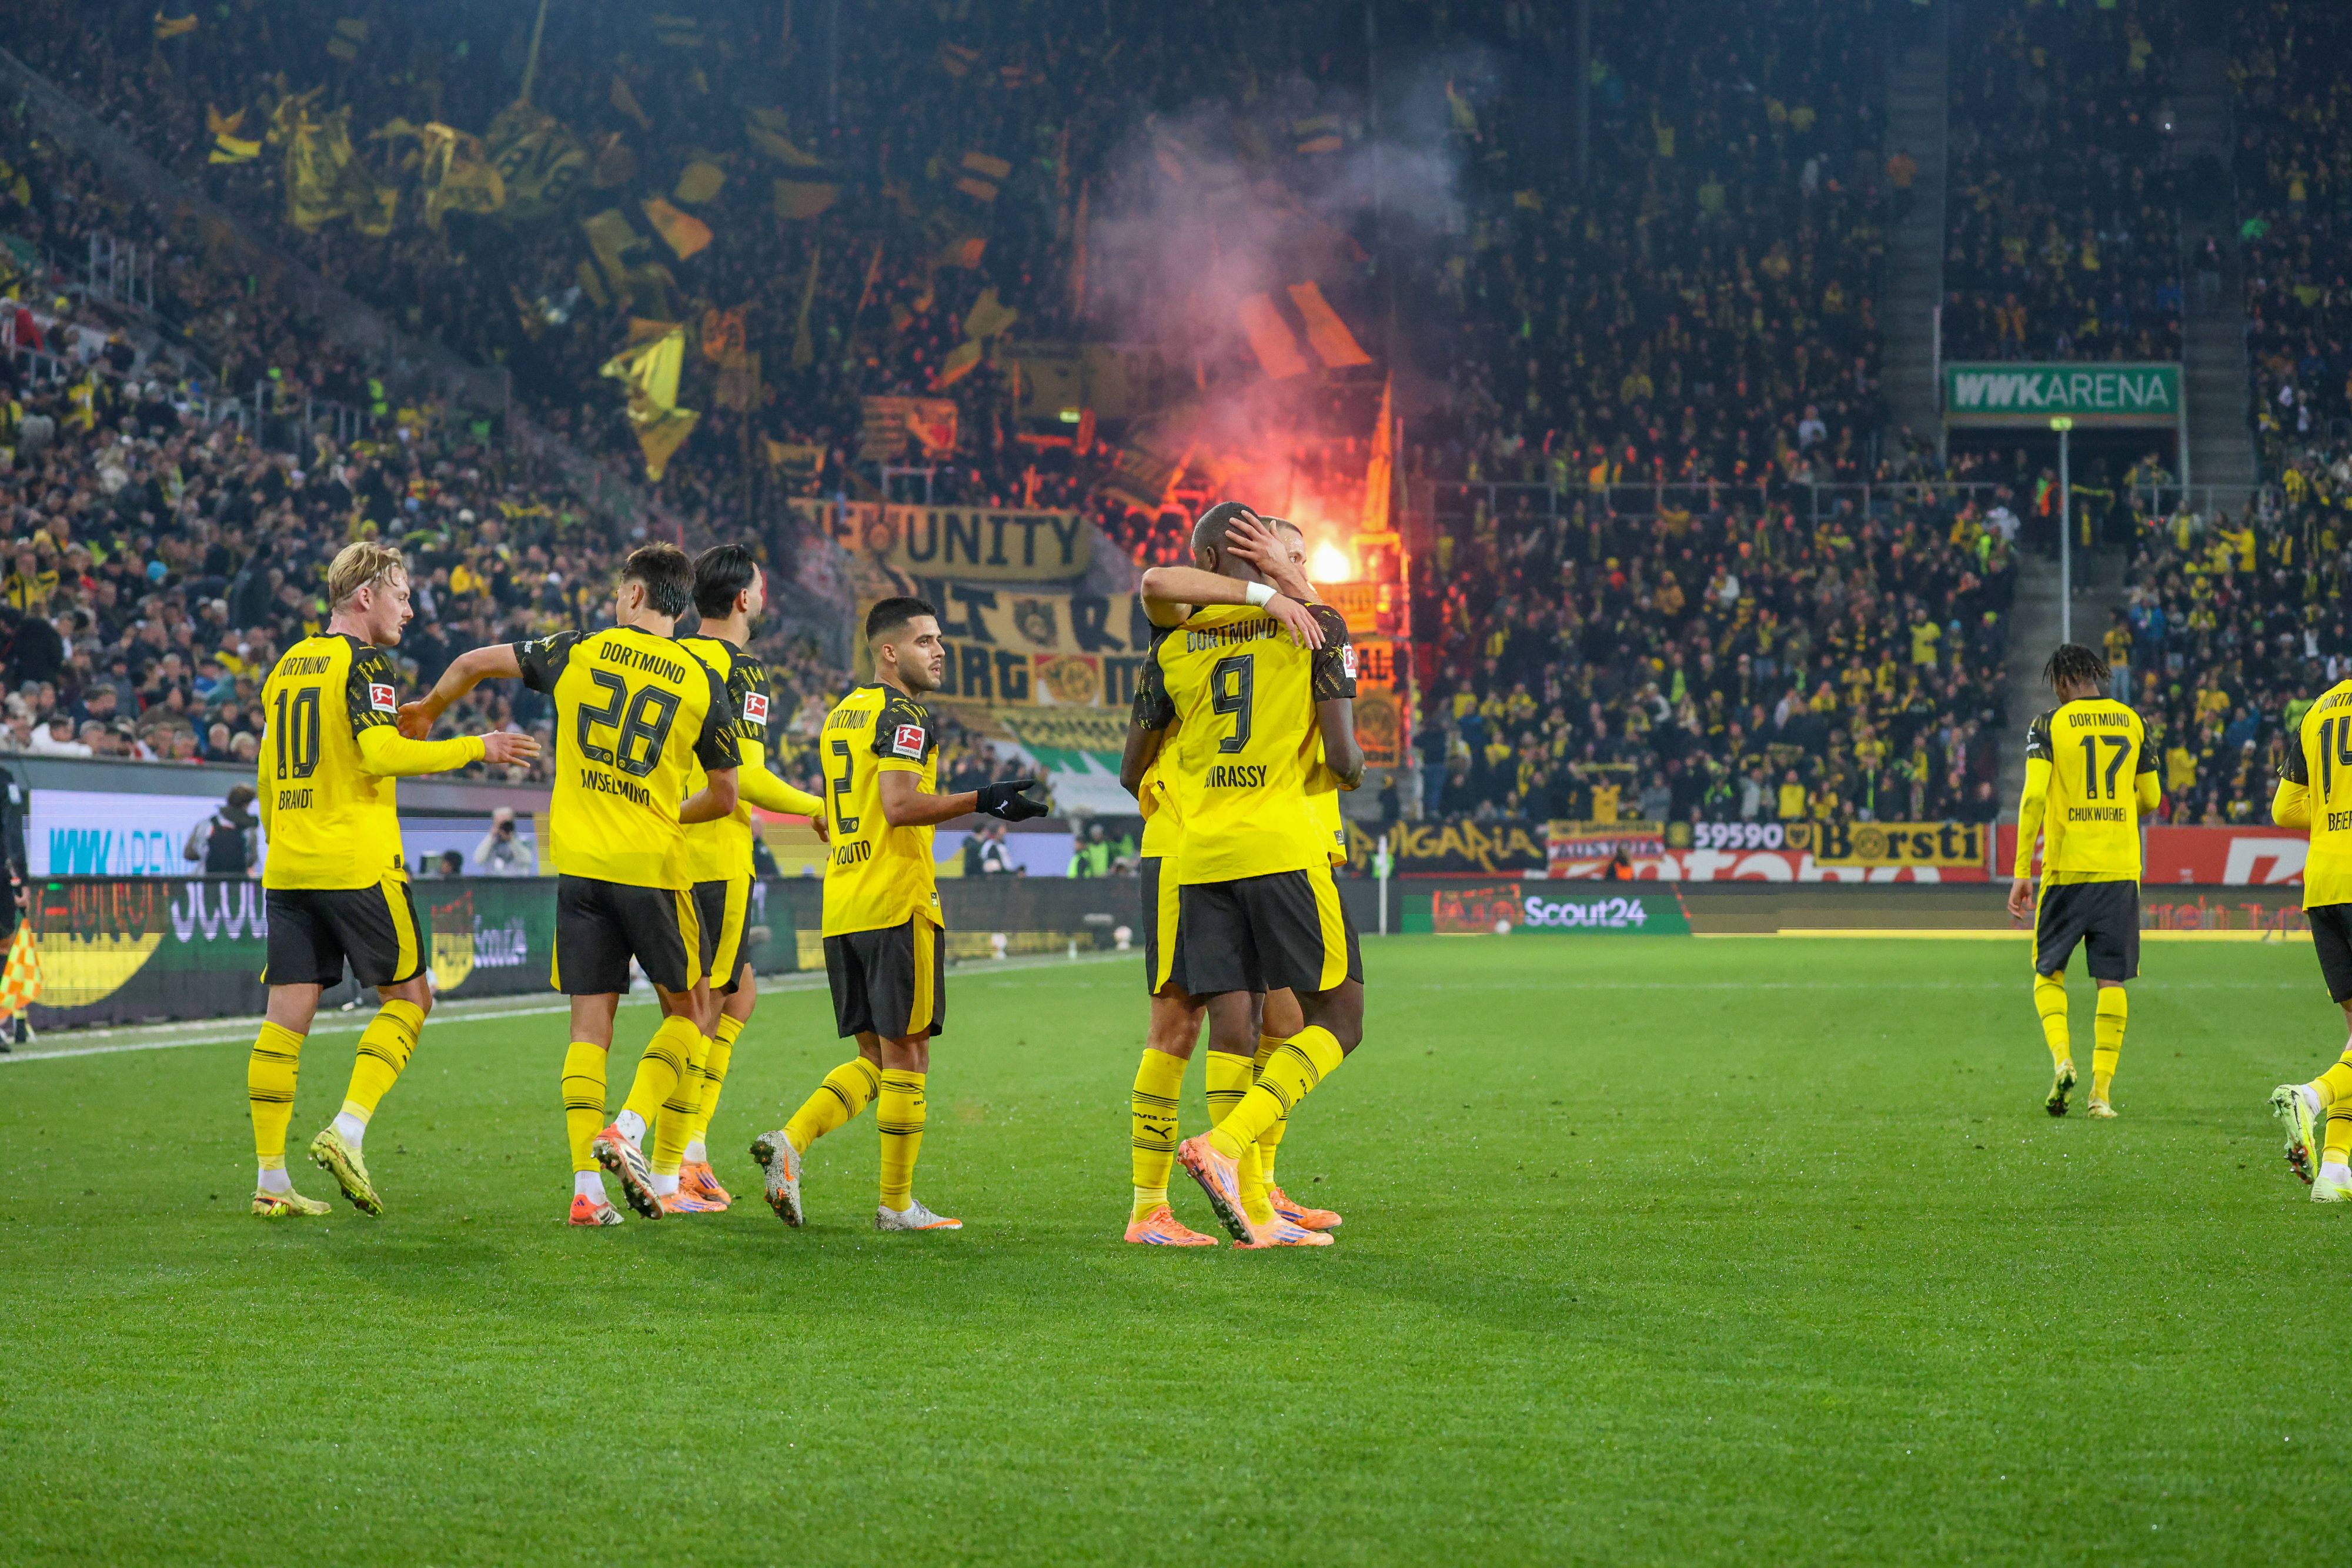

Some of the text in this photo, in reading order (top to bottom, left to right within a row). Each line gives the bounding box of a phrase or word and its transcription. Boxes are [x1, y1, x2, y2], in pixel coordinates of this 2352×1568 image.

[906, 512, 1082, 567] UNITY
[1187, 617, 1278, 654] DORTMUND
[599, 641, 686, 684] DORTMUND
[827, 709, 871, 731] DORTMUND
[1210, 653, 1254, 754] 9
[2069, 713, 2130, 728] DORTMUND
[274, 687, 320, 780] 10
[577, 667, 682, 778] 28
[896, 747, 919, 756] BUNDESLIGA
[2079, 735, 2132, 800] 17
[278, 788, 313, 810] BRANDT
[581, 768, 650, 807] ANSELMINO
[831, 739, 860, 835] 2
[837, 840, 871, 865] COUTO
[1694, 822, 1784, 848] 59590
[1524, 895, 1647, 928] Scout24
[1132, 1111, 1157, 1121] BVB
